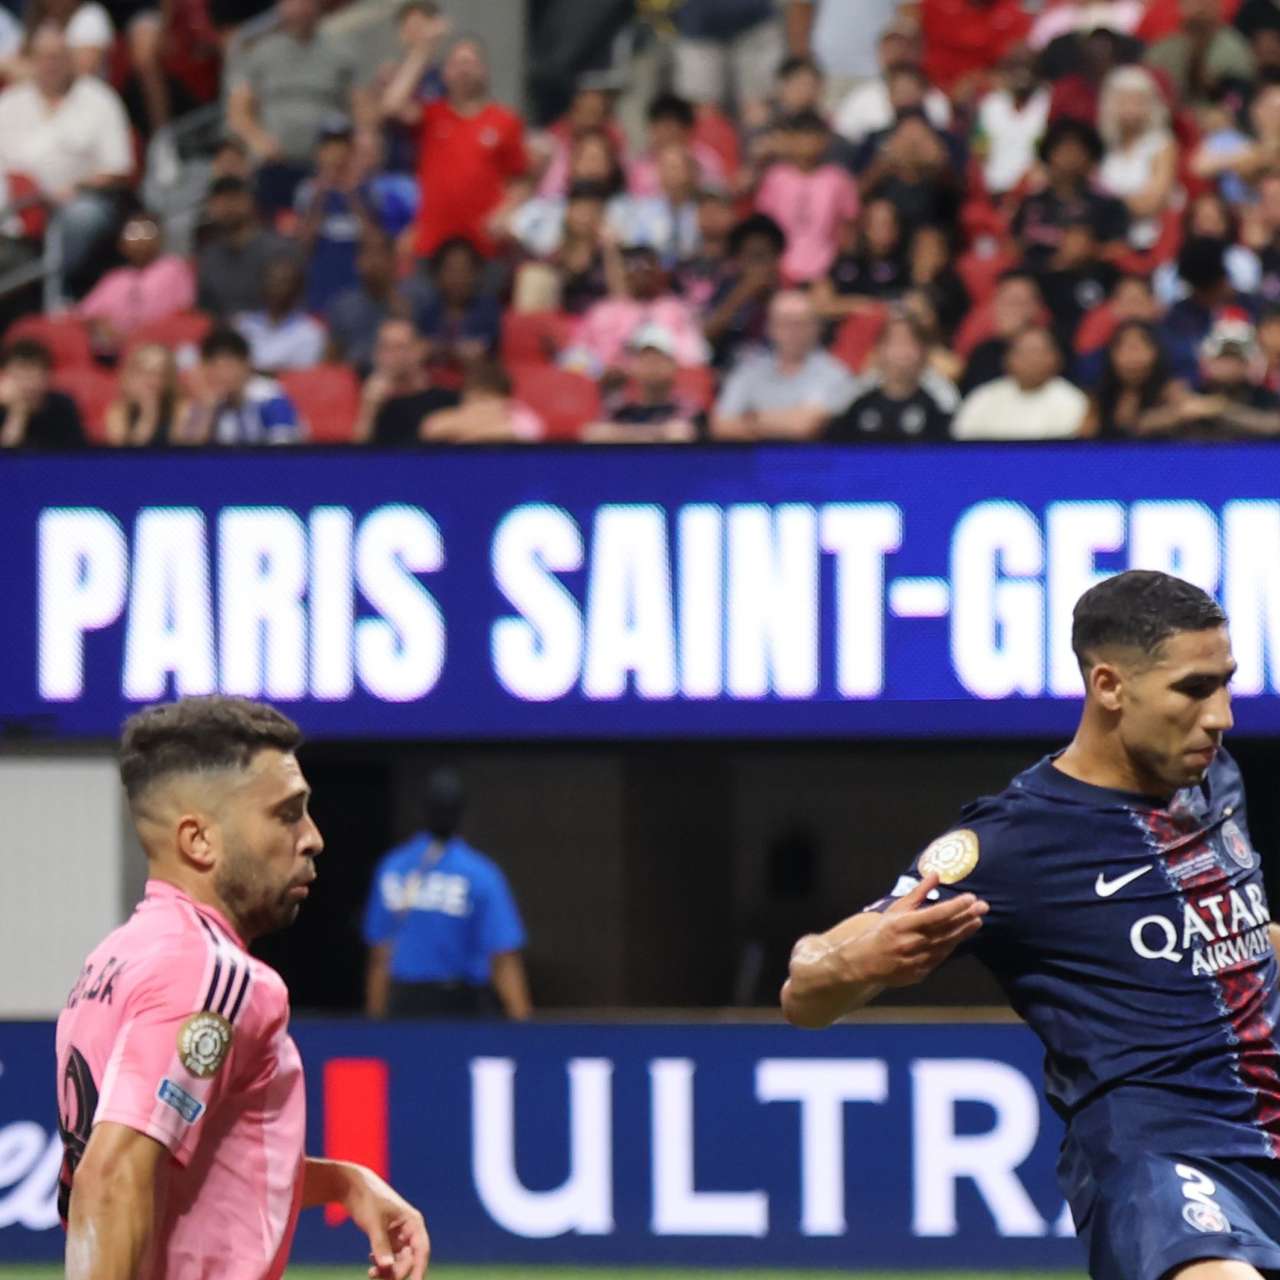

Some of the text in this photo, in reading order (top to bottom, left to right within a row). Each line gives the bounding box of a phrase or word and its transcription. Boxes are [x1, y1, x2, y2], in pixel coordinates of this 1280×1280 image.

[37, 504, 446, 703] PARIS
[1130, 884, 1271, 962] QATAR
[469, 1056, 1078, 1238] ULTR
